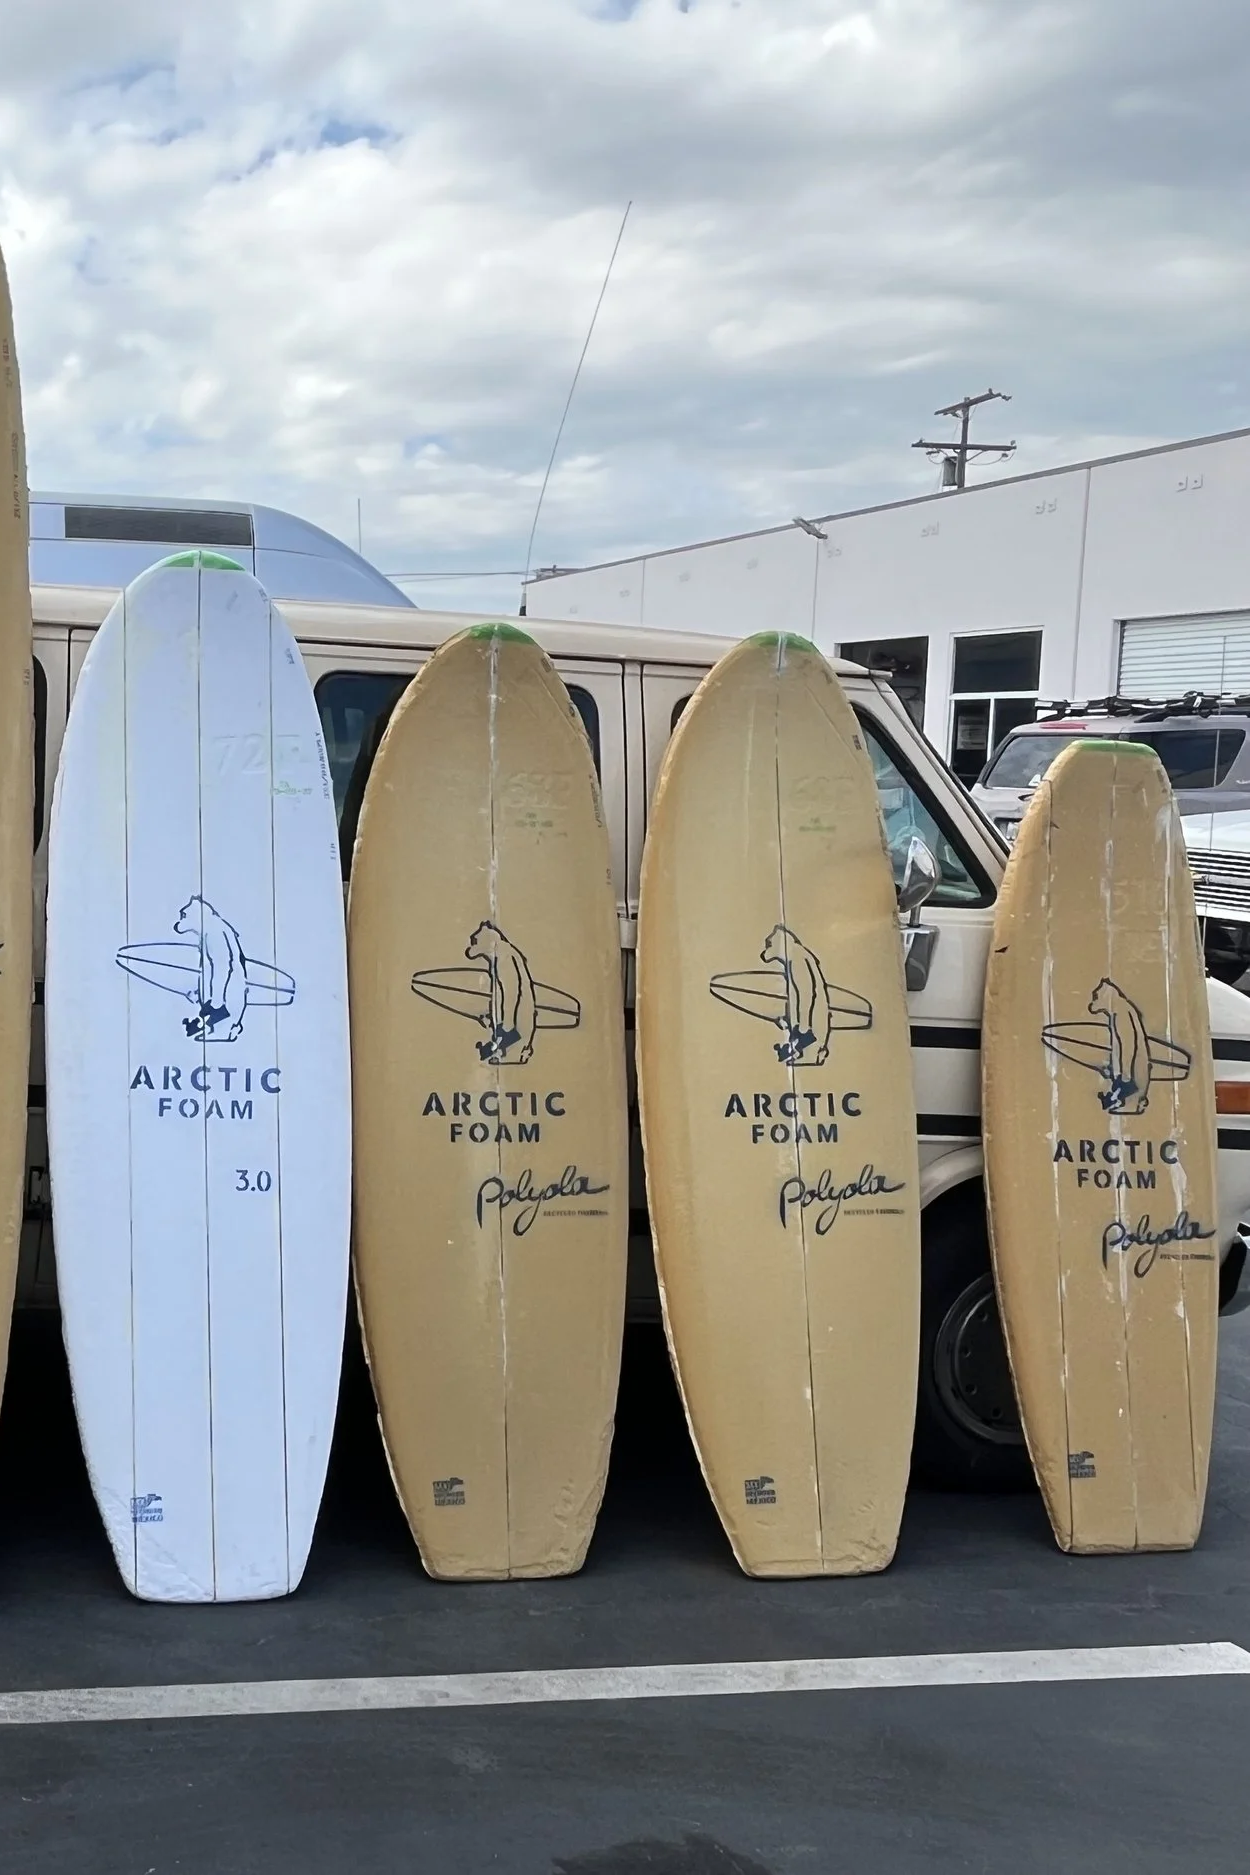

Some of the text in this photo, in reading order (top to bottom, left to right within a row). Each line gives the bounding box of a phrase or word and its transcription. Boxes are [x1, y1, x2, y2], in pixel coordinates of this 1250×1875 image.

[129, 1064, 282, 1094] ARCTIC
[158, 1097, 253, 1120] FOAM
[421, 1090, 566, 1117] ARCTIC
[724, 1092, 862, 1118] ARCTIC
[450, 1122, 540, 1144] FOAM
[752, 1123, 838, 1144] FOAM
[1052, 1138, 1179, 1165] ARCTIC
[235, 1169, 272, 1192] 3.0
[1076, 1168, 1156, 1190] FOAM
